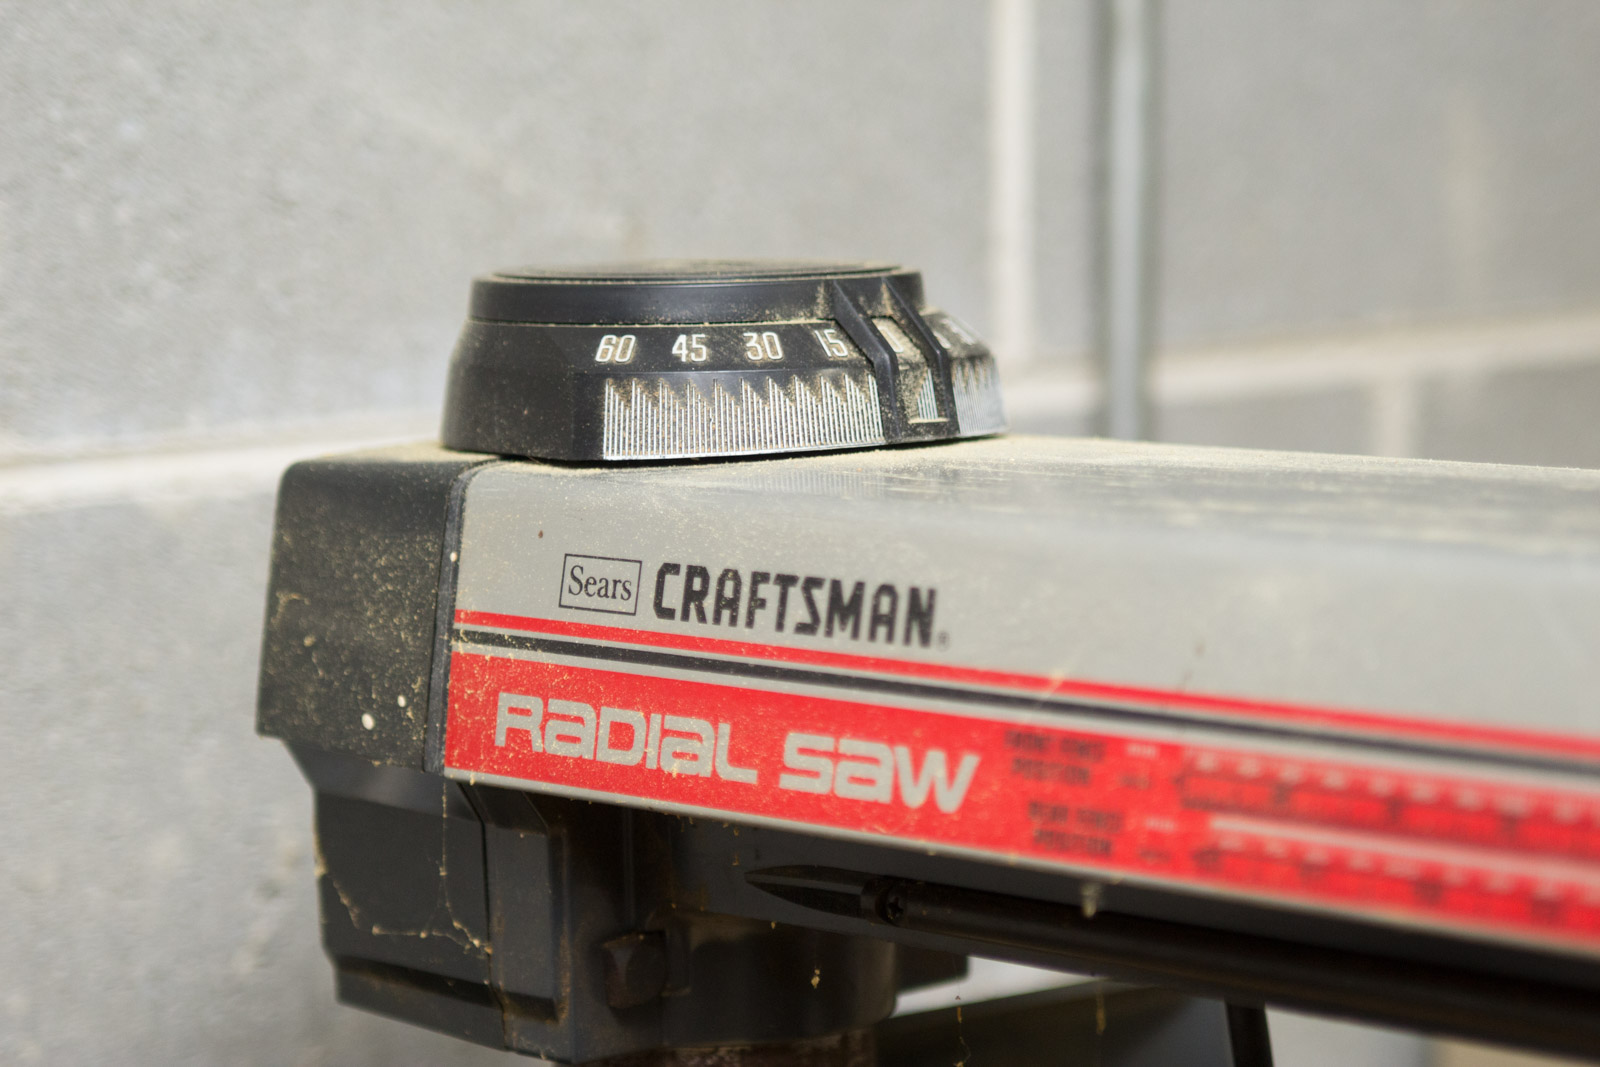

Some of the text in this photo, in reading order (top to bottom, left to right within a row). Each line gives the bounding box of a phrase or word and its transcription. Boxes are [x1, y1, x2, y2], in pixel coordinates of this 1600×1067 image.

[595, 334, 636, 362] 60
[671, 334, 707, 362] 45
[743, 331, 783, 360] 30
[814, 329, 848, 357] 15
[568, 562, 937, 648] Sears CRAFTSMAN
